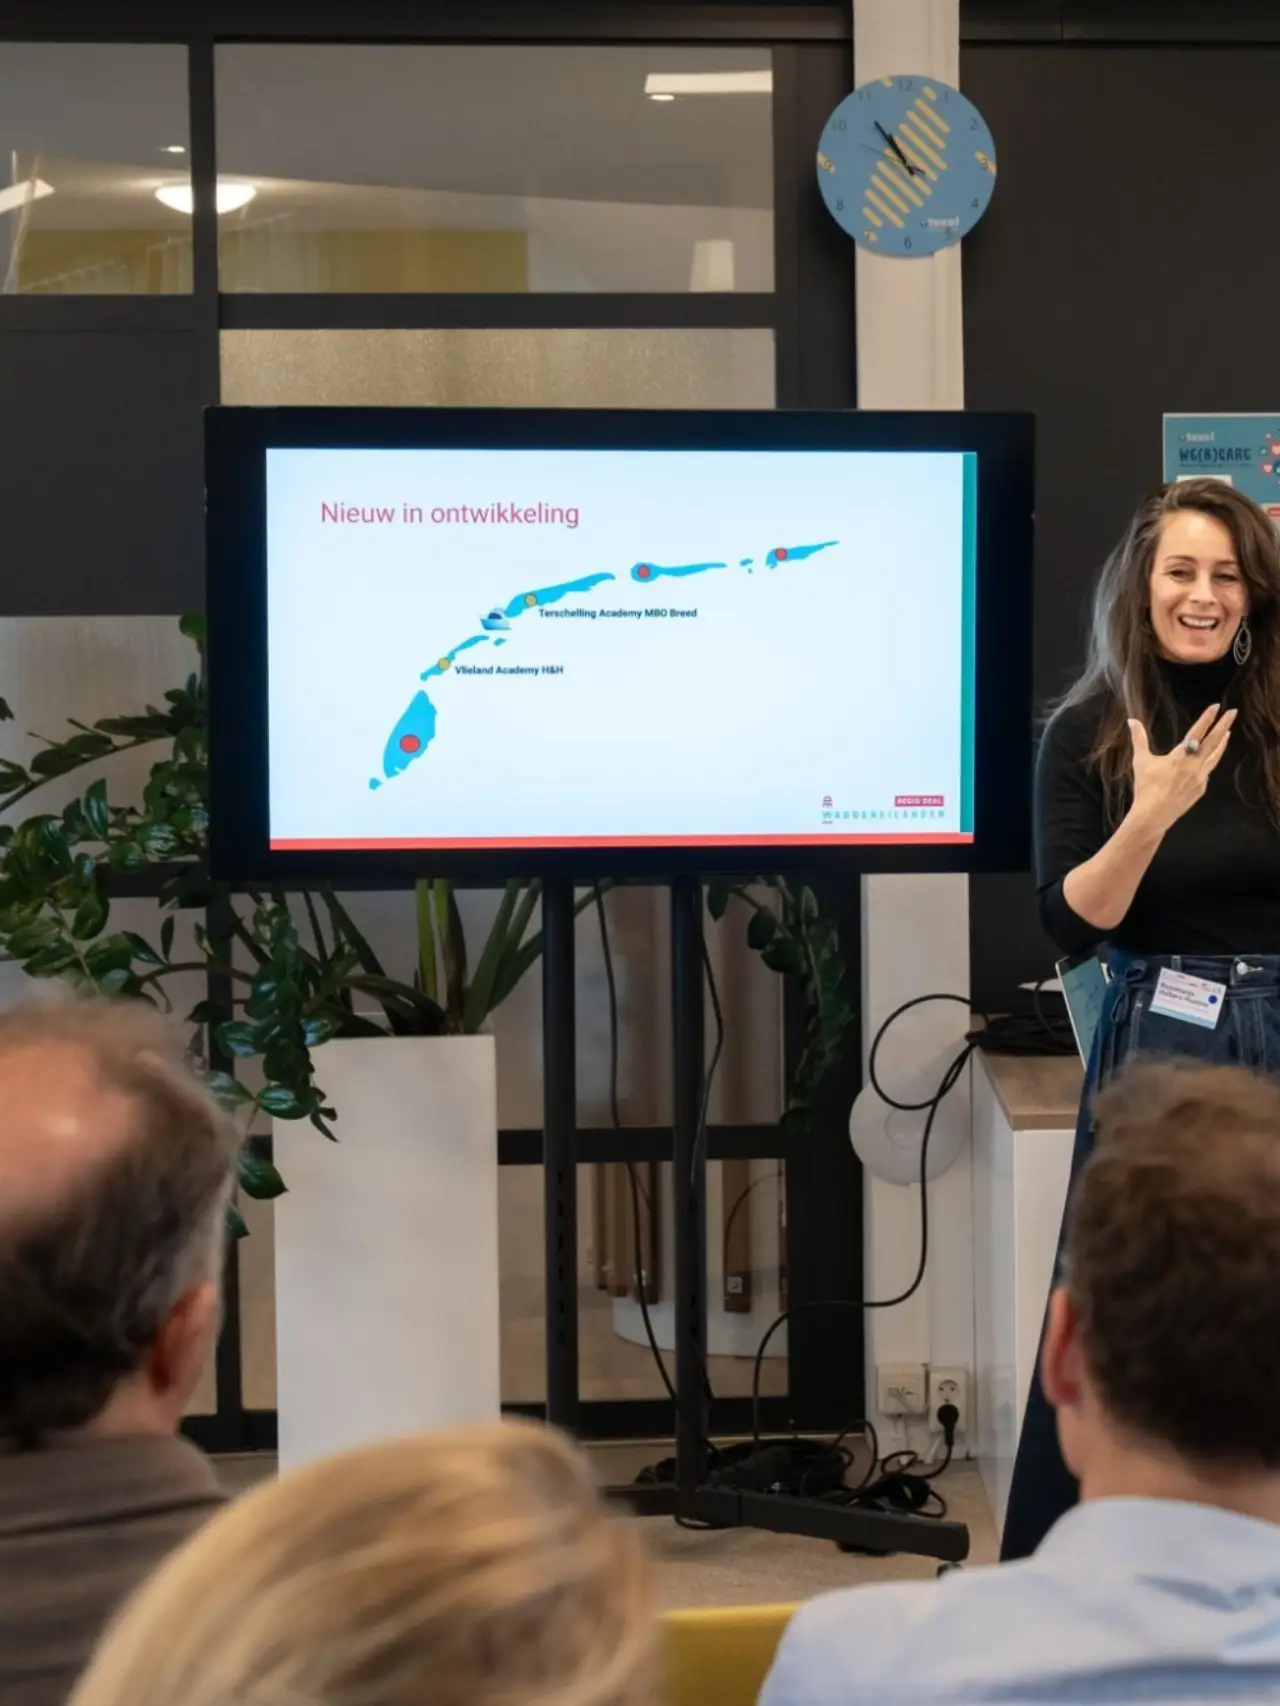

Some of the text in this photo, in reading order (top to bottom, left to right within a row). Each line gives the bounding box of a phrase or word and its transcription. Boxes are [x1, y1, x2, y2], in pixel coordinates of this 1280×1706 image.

[898, 79, 913, 92] 12
[858, 91, 872, 102] 11
[831, 119, 847, 132] 10
[969, 117, 979, 131] 2
[836, 198, 844, 212] 8
[904, 235, 913, 250] 6
[321, 502, 579, 529] Nieuw in ontwikkeling
[539, 608, 697, 619] Terschelling Academy MBO Breed
[455, 665, 564, 676] Vlieland Academy H&H
